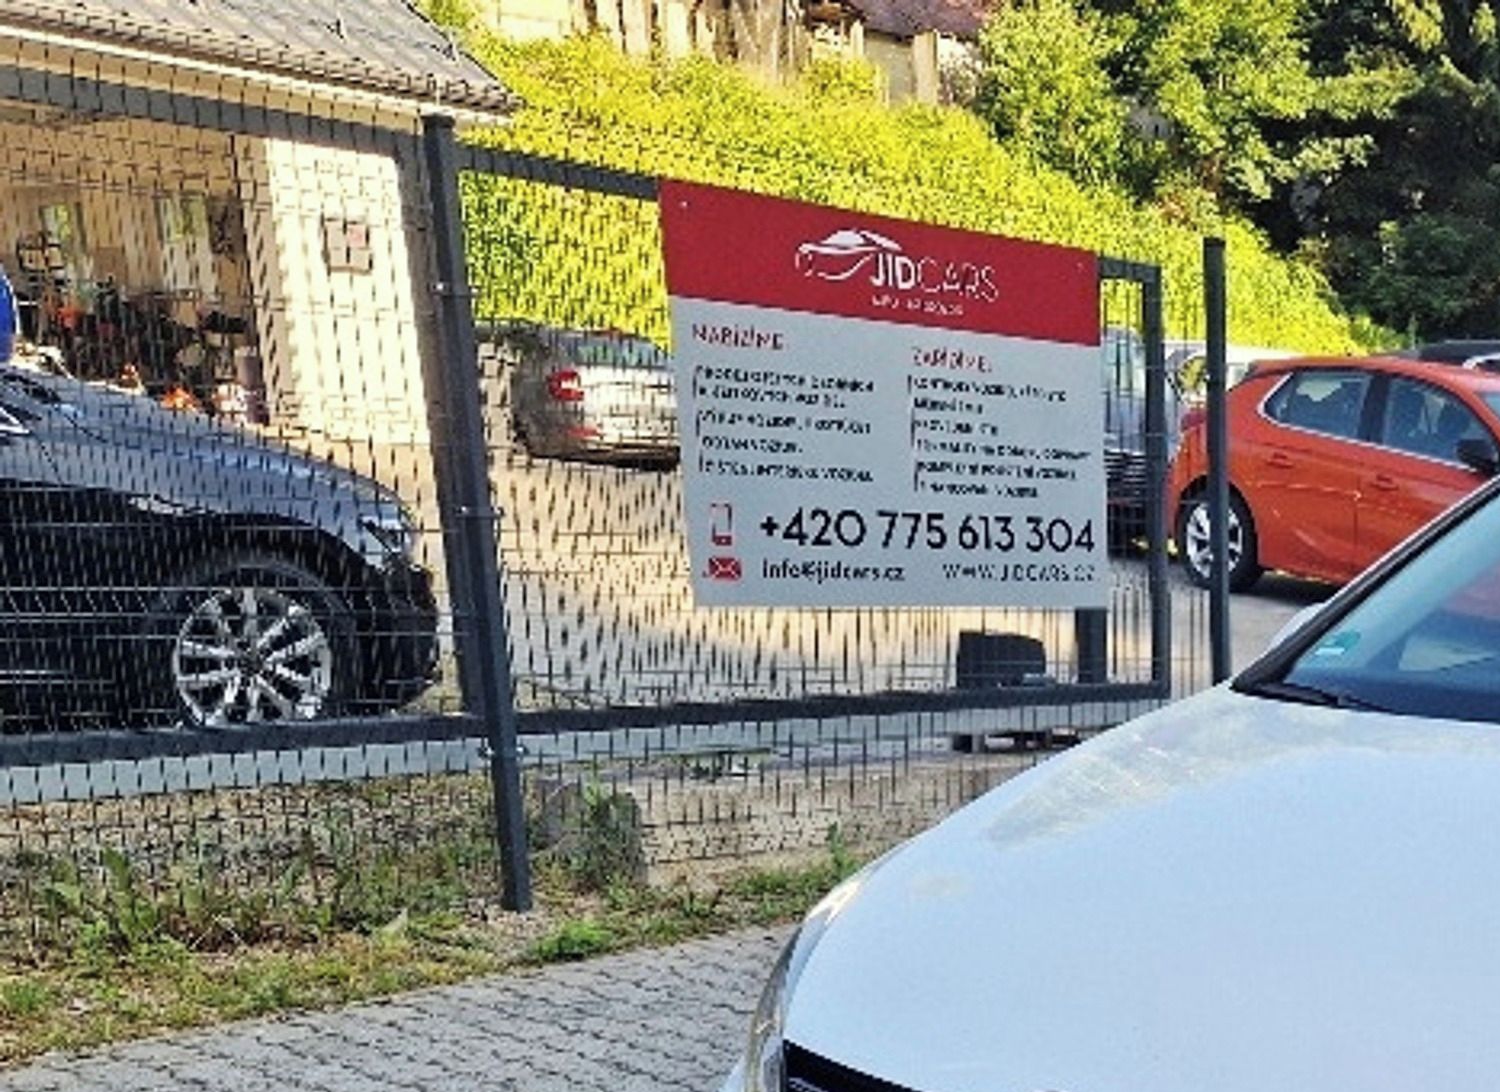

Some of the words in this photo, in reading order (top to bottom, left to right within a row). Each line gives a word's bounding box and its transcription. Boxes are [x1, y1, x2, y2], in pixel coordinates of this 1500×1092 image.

[869, 252, 999, 303] JIDCARS
[760, 506, 867, 547] +420
[876, 509, 947, 550] 775
[957, 514, 1016, 552] 613
[1025, 517, 1095, 552] 304
